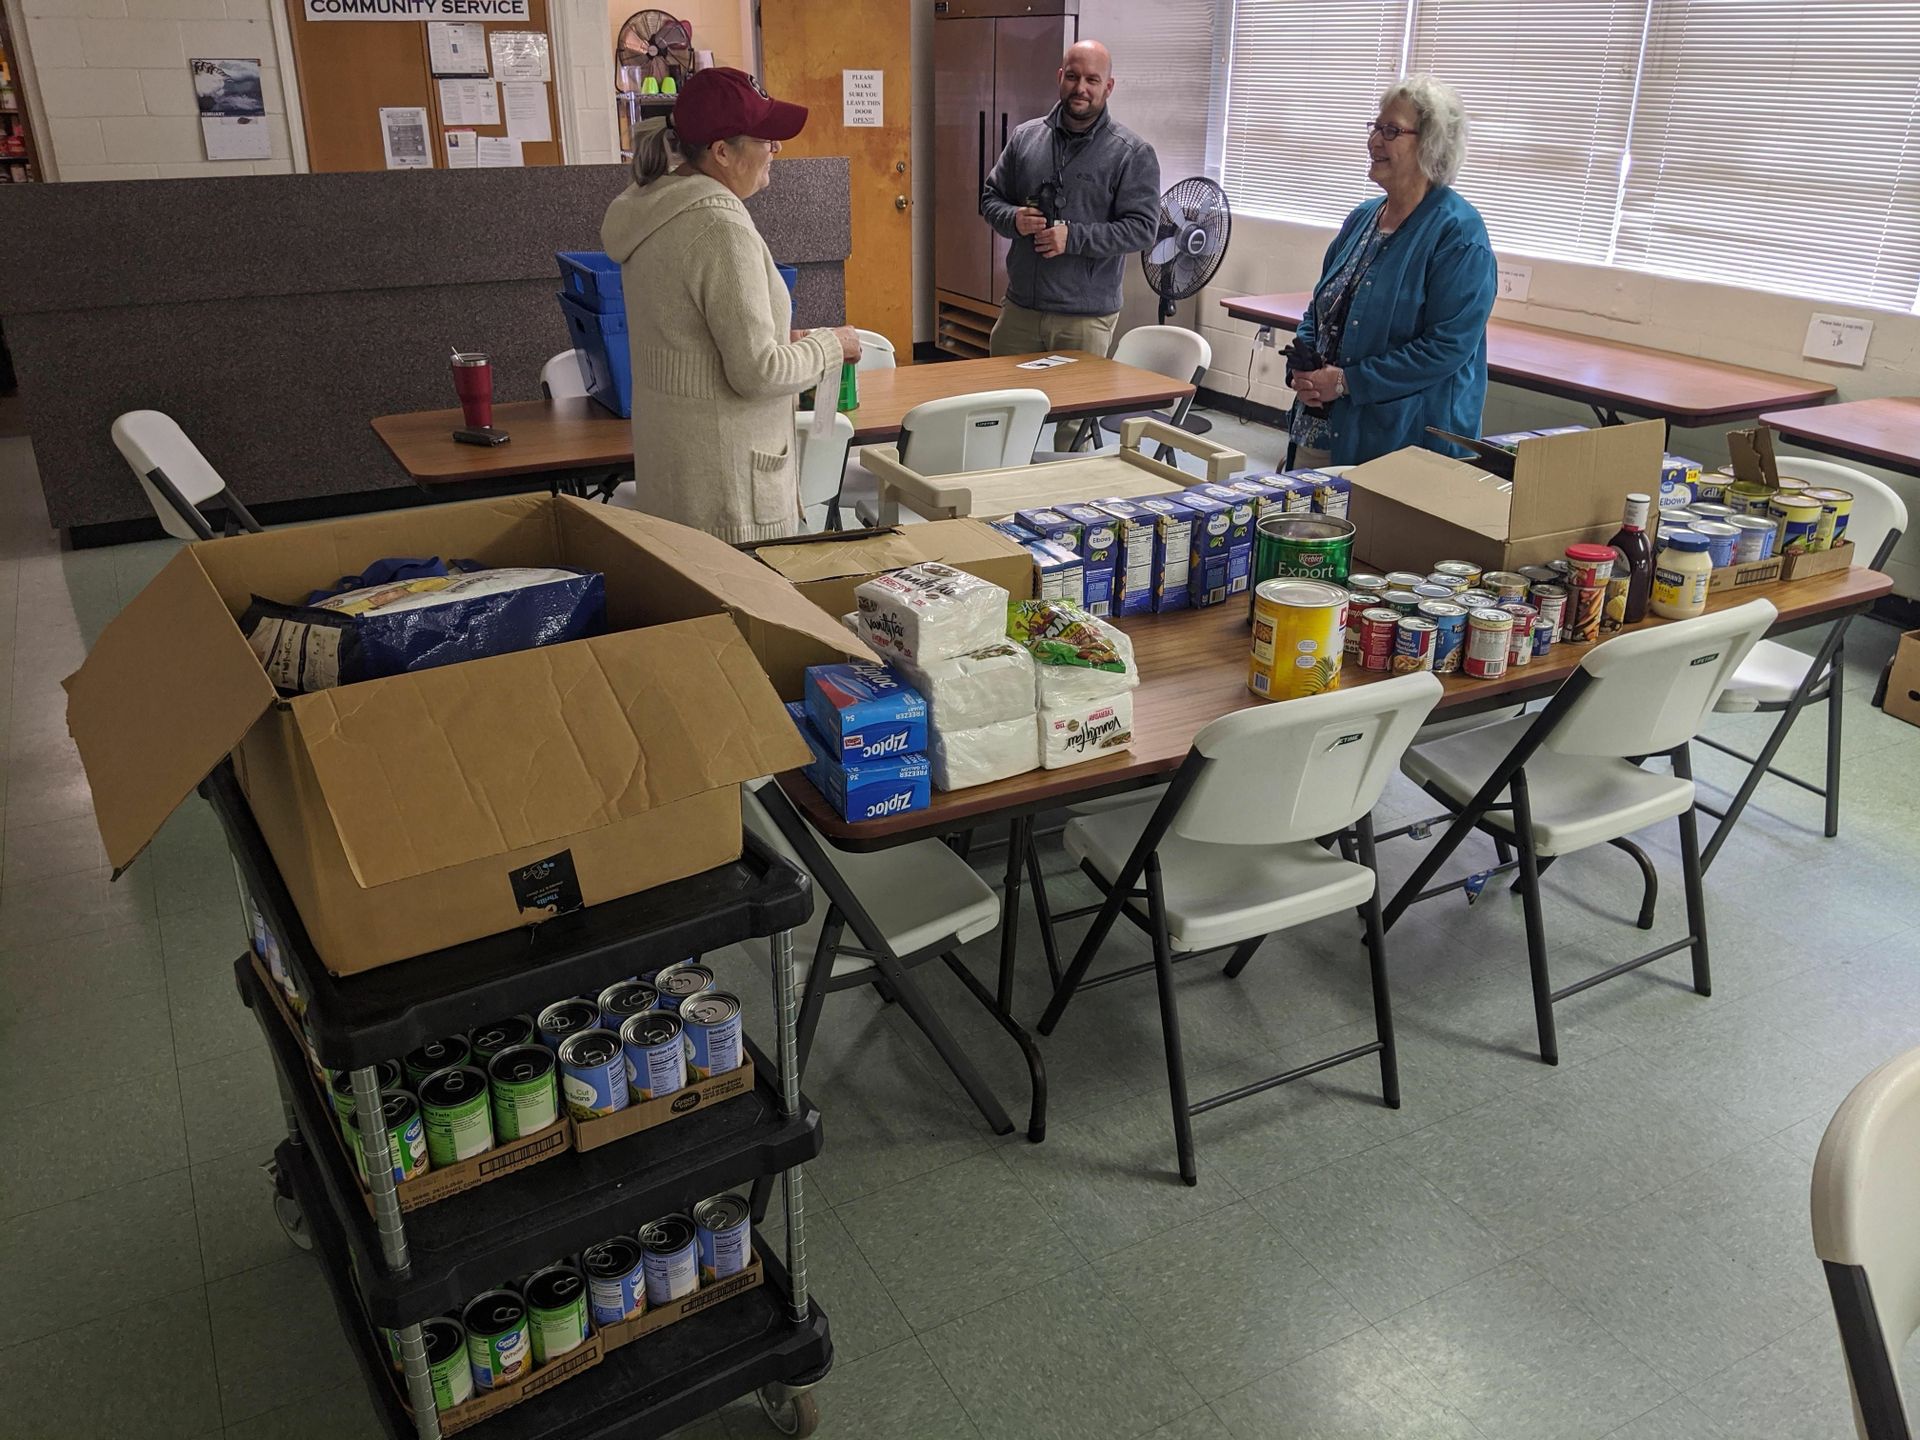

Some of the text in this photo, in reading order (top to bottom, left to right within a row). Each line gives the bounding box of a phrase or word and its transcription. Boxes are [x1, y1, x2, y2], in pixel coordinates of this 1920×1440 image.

[310, 0, 524, 14] COMMUNITY SERVICE
[1660, 496, 1686, 506] Elbows
[1211, 522, 1228, 530] Elbows
[1092, 536, 1112, 544] Elbows
[1278, 561, 1334, 579] Export
[846, 714, 855, 722] 54
[896, 710, 924, 720] FREEZER
[1088, 708, 1114, 722] EVERYDAY
[862, 731, 908, 758] Ziploc
[850, 772, 859, 781] 36
[900, 768, 928, 778] FREEZER
[866, 790, 912, 818] Ziploc
[576, 1088, 590, 1096] Cut
